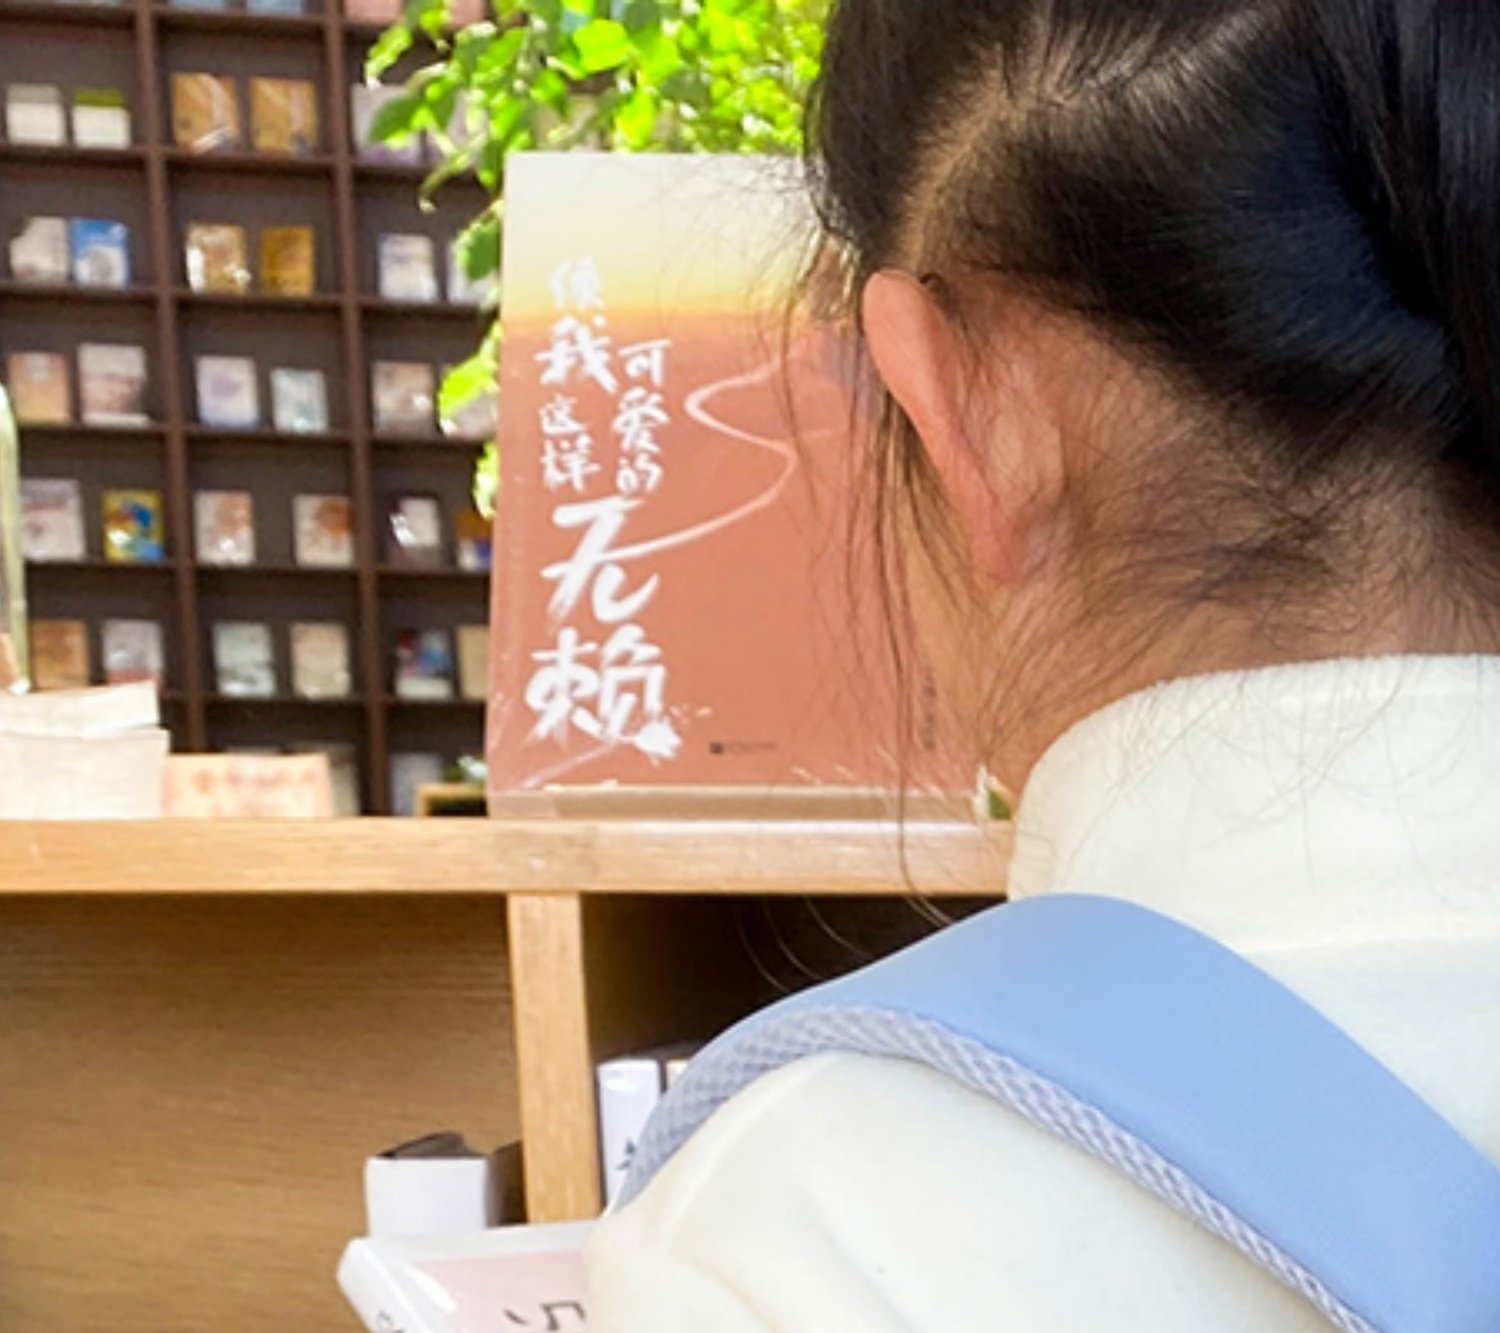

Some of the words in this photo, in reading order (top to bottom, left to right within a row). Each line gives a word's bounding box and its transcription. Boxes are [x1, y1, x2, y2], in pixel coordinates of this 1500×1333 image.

[615, 338, 672, 493] 可爱的
[526, 496, 682, 764] 无赖
